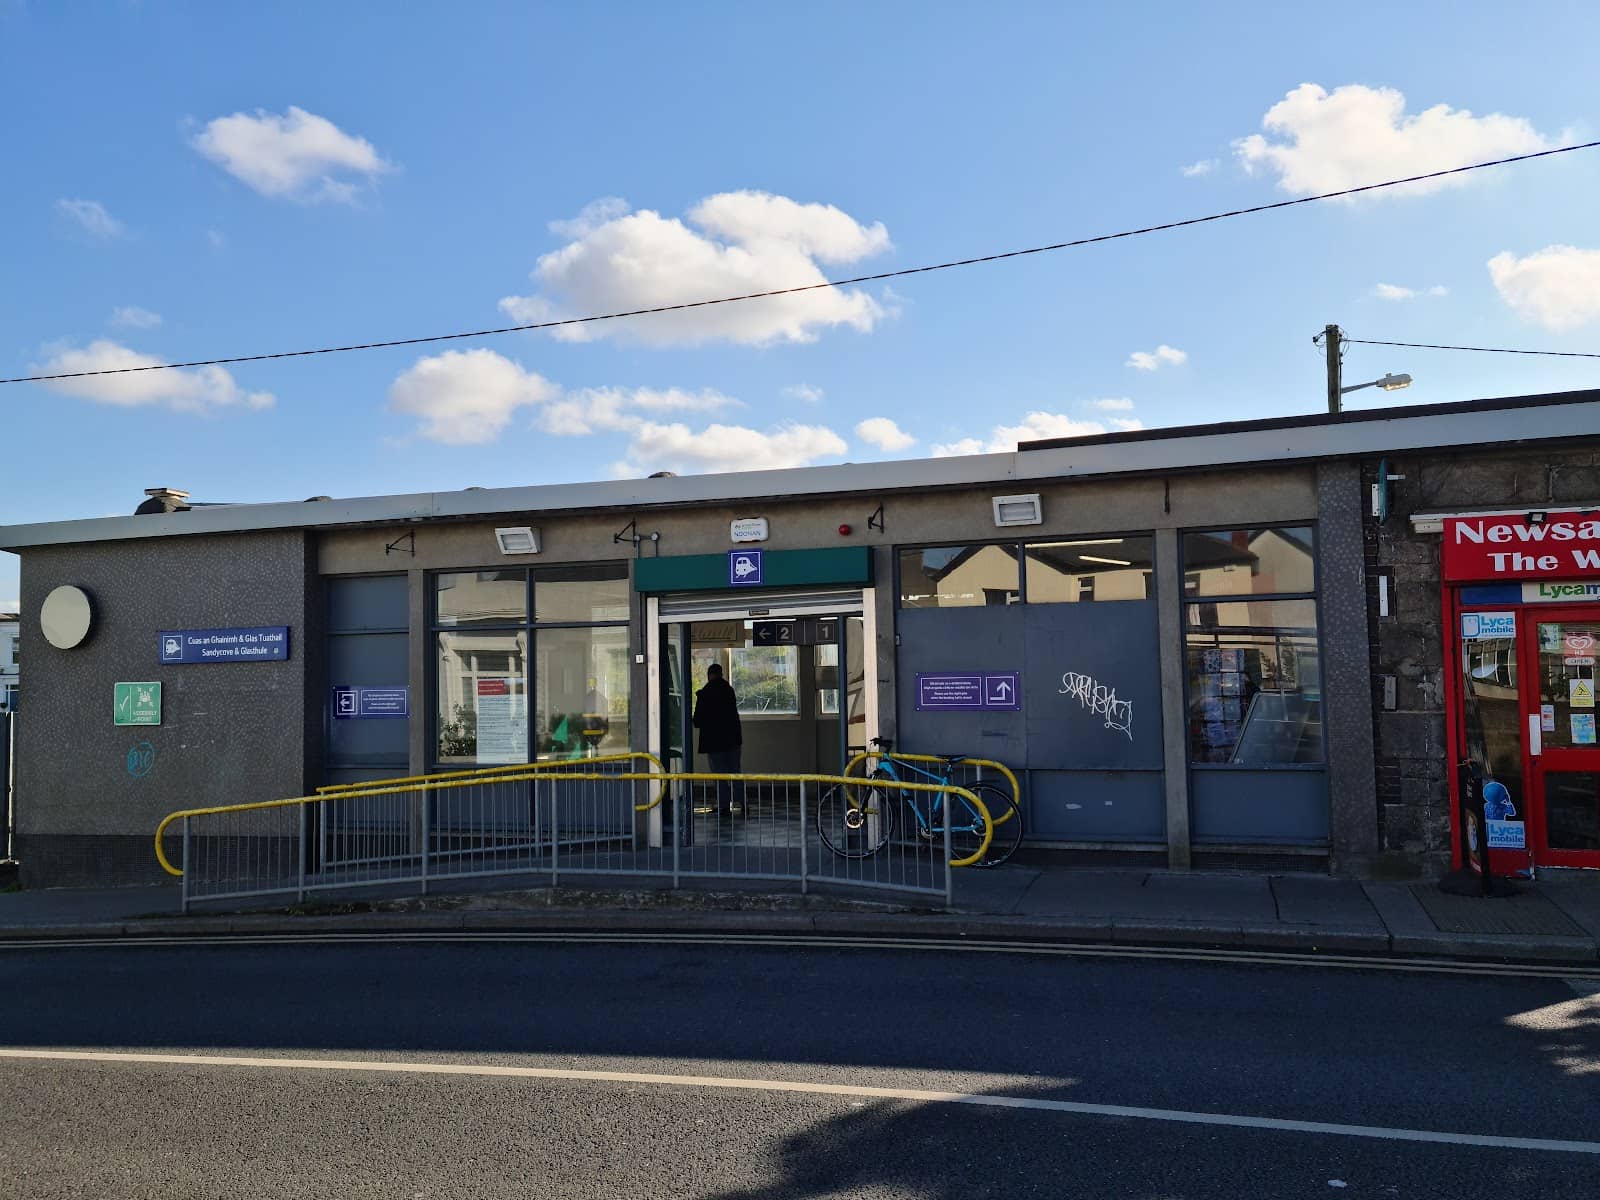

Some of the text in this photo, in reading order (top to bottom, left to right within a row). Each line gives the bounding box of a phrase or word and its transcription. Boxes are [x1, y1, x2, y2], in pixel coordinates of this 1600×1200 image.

[1486, 552, 1559, 572] The
[1481, 616, 1514, 627] Lyca
[780, 627, 789, 640] 2
[822, 627, 830, 639] 1
[1481, 625, 1514, 633] mobile
[187, 636, 202, 645] Cuas
[244, 633, 258, 642] Glas
[258, 632, 283, 641] Tuathail
[202, 647, 233, 658] Sandycove
[240, 646, 268, 655] Glasthule
[1490, 823, 1524, 836] Lyca
[1490, 835, 1524, 844] mobile
